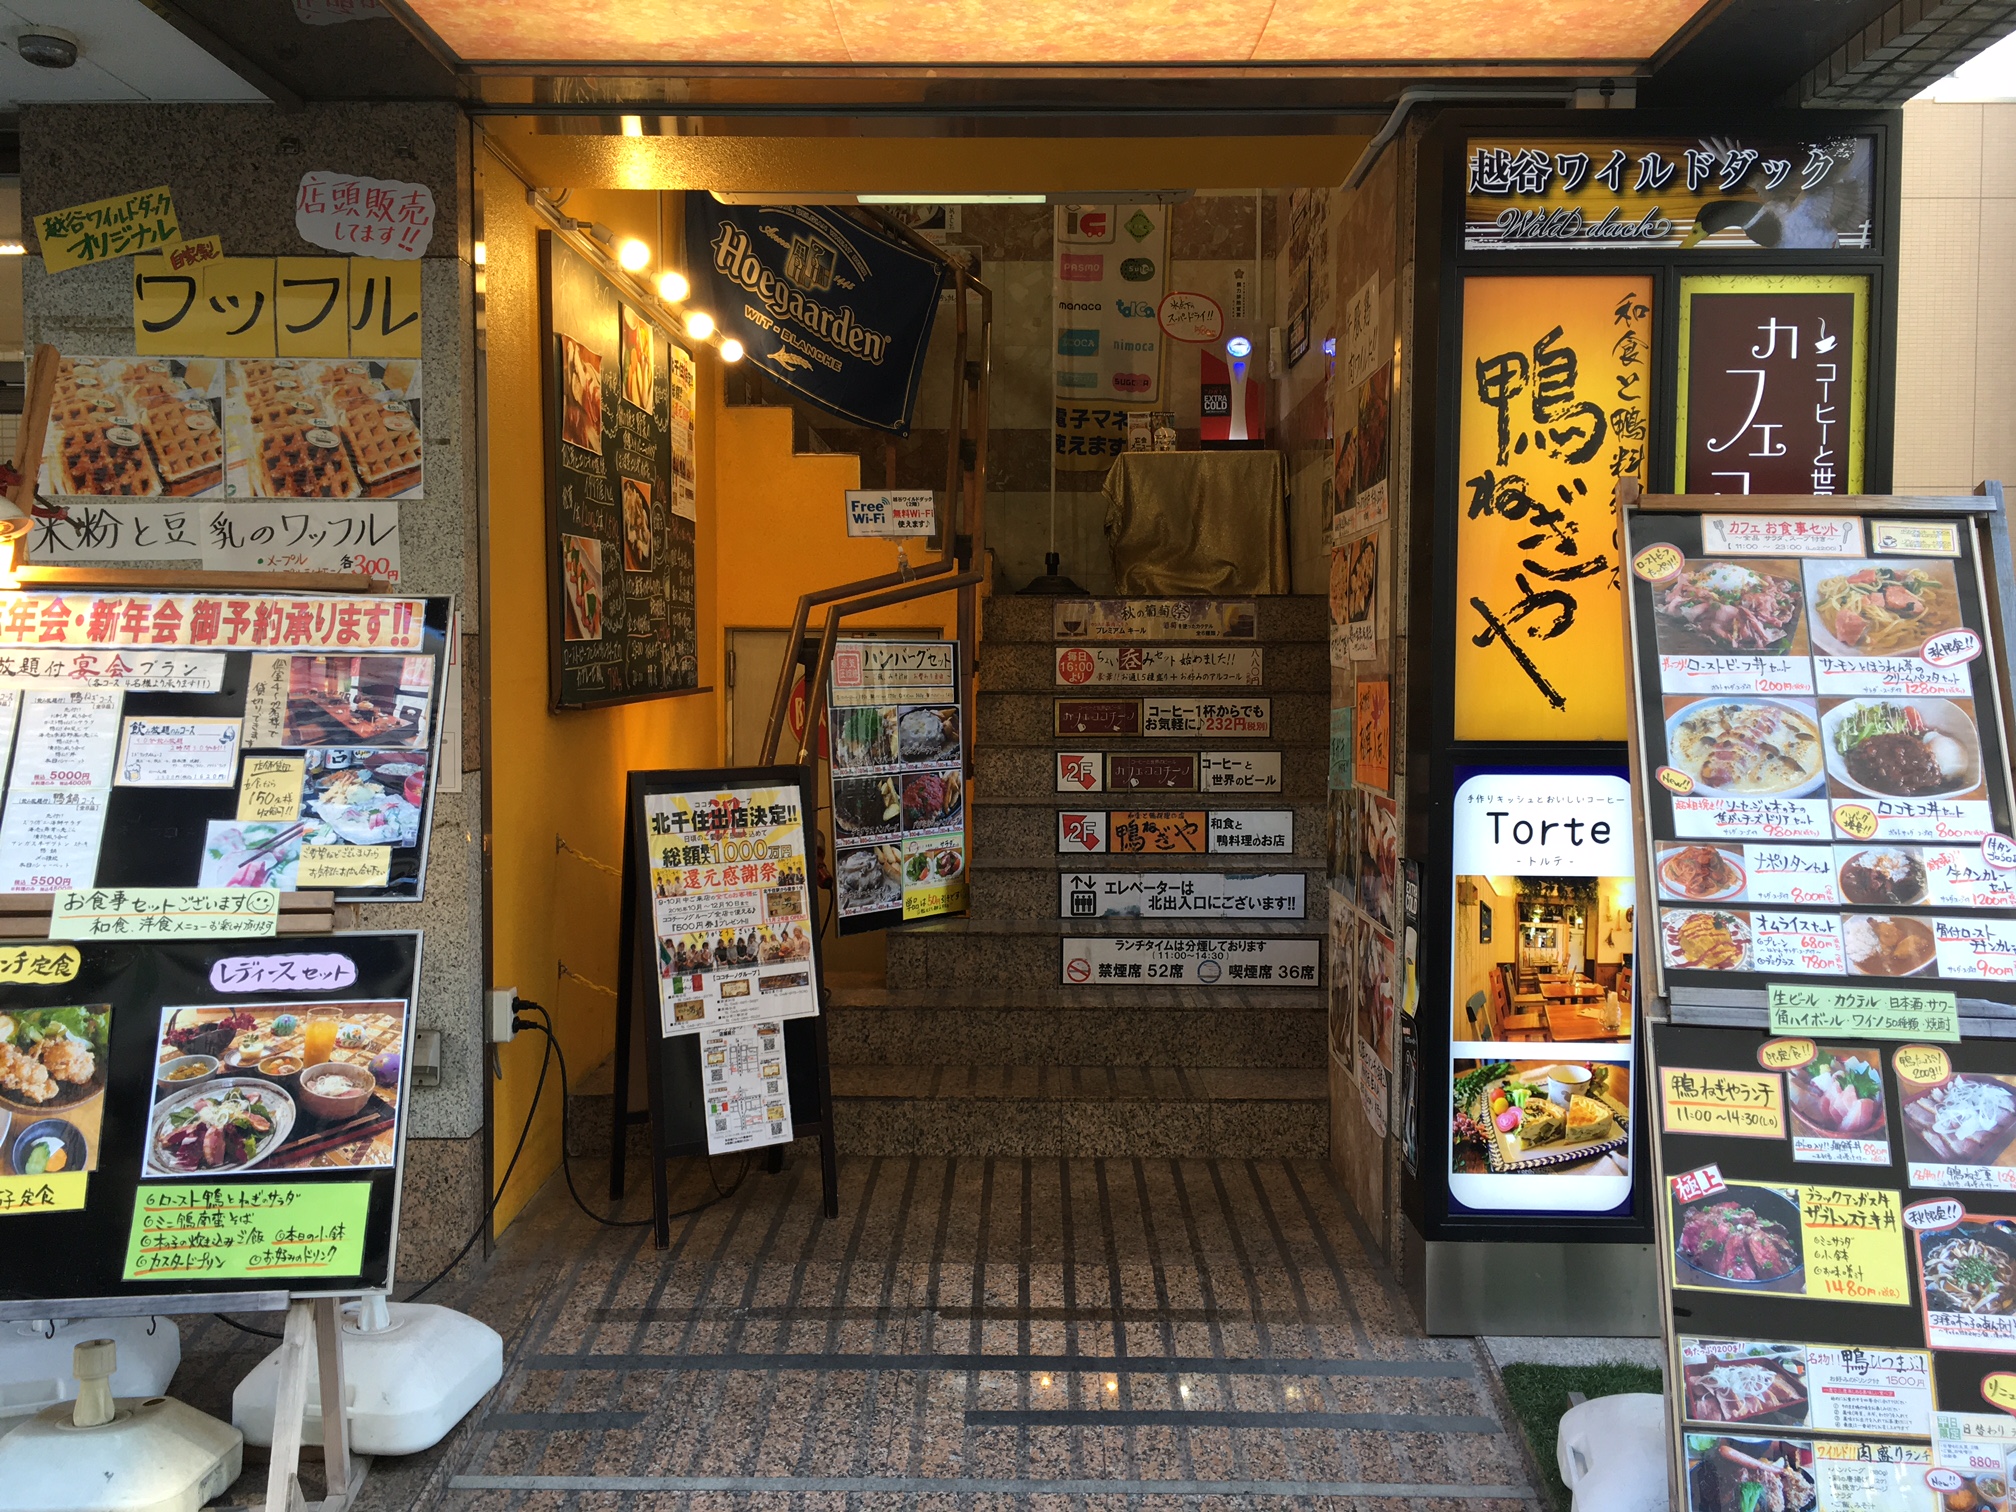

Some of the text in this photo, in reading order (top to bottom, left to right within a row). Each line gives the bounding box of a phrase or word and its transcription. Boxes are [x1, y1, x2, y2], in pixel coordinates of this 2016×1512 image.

[1469, 147, 1835, 194] 越谷ワイルドダック
[300, 176, 433, 228] 店頭販売
[44, 192, 171, 241] 越谷ワイルドダック
[67, 219, 177, 261] オリジナル
[336, 221, 421, 253] してます!!
[170, 240, 220, 270] 自家製
[1064, 263, 1154, 274] PASMO Suica
[711, 221, 885, 366] Hoegaarden
[136, 272, 418, 336] ワッフル
[1059, 302, 1102, 311] manaca
[744, 304, 843, 373] WIT BLANCHE
[1113, 339, 1154, 352] nimoca
[1204, 402, 1228, 410] COLD
[1811, 364, 1837, 495] コーヒーと世
[1056, 435, 1127, 457] 使えます
[851, 501, 884, 513] Free
[892, 509, 934, 518] 無料Wi-Fi
[853, 513, 886, 524] Wi-Fi
[1467, 325, 1608, 712] 鴨ねぎや
[1729, 521, 1839, 535] カフェ お食事セット
[267, 553, 308, 566] メープル
[0, 597, 413, 646] 年会・新年会御予約承ります!!
[864, 648, 951, 669] ハンバーグセット
[1067, 652, 1087, 662] 毎日
[1180, 653, 1236, 666] 始めました!!
[1060, 662, 1093, 672] 16:00
[1819, 659, 1924, 673] サーモンとほうれん草の
[1069, 673, 1086, 682] より
[1149, 705, 1264, 718] コーヒー1杯からでも
[50, 771, 90, 780] 5000円
[1067, 762, 1093, 782] 2F
[1212, 774, 1277, 787] 世界のビール
[1662, 772, 1691, 790] New!!
[1468, 794, 1625, 804] 手作りキッシュとおいしいコーヒー
[652, 804, 798, 835] 北千住出店決定!!
[1210, 817, 1243, 830] 和食と
[1069, 821, 1097, 842] 2F
[1116, 819, 1199, 851] 鴨ねぎや
[1486, 811, 1611, 846] Torte
[1217, 833, 1285, 847] 鴨料理のお店
[1754, 852, 1830, 873] ナポリタンセット
[31, 876, 71, 886] 5500円
[683, 863, 779, 890] 還元感謝祭
[1105, 881, 1194, 895] エレベーターは
[1791, 887, 1826, 904] 800円
[1989, 881, 2013, 893] セット
[64, 891, 247, 914] お食事セットございます
[1148, 894, 1296, 911] 北出入口にございます!!
[1756, 914, 1836, 933] オムライスセット
[1115, 939, 1267, 952] ランチタイムは分煙しております
[1801, 936, 1833, 949] 680円
[1801, 955, 1834, 969] 780円
[1976, 959, 2014, 977] 900円
[220, 961, 350, 983] レディースセット
[1098, 964, 1315, 980] 禁煙席 52席 喫煙席 36席
[1671, 1073, 1775, 1107] 鴨ねぎやランチ
[1675, 1171, 1724, 1203] 極上
[0, 1184, 55, 1209] 子定食
[285, 1222, 346, 1242] 本日の小鉢
[1819, 1235, 1854, 1249] ミニサラダ
[1807, 1348, 1927, 1376] 名物!! 鴨ひつまぶし
[1885, 1375, 1925, 1387] 1500円
[1963, 1423, 2005, 1437] 日替わり
[1970, 1456, 2001, 1468] 880円
